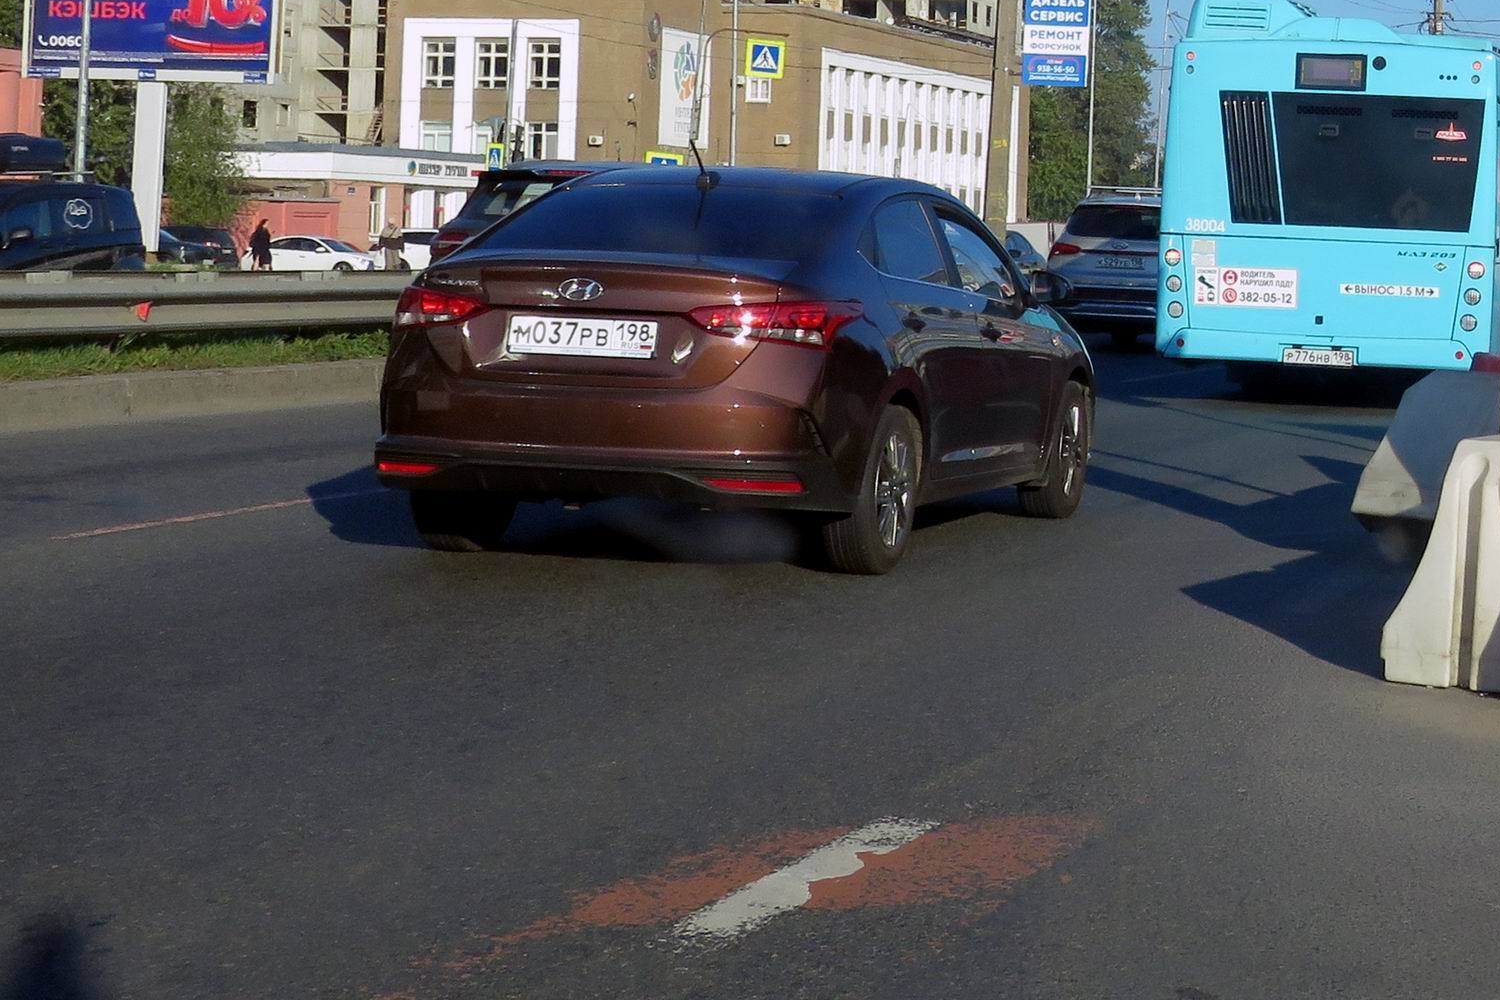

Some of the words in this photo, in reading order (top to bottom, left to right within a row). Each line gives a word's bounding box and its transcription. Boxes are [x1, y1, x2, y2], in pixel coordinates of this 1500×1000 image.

[48, 0, 146, 19] КЭШБЭК
[1030, 10, 1084, 22] СЕРВИС
[1030, 30, 1082, 40] РЕМОНТ
[1030, 42, 1081, 51] ФОРСУНОК
[1185, 218, 1225, 232] 38004
[1240, 279, 1273, 287] НАРУШИЛ
[1355, 285, 1395, 295] ВЫНОС
[1240, 291, 1292, 304] 382-05-12
[617, 323, 650, 341] 198
[621, 342, 639, 350] RUS
[1333, 352, 1350, 361] 198
